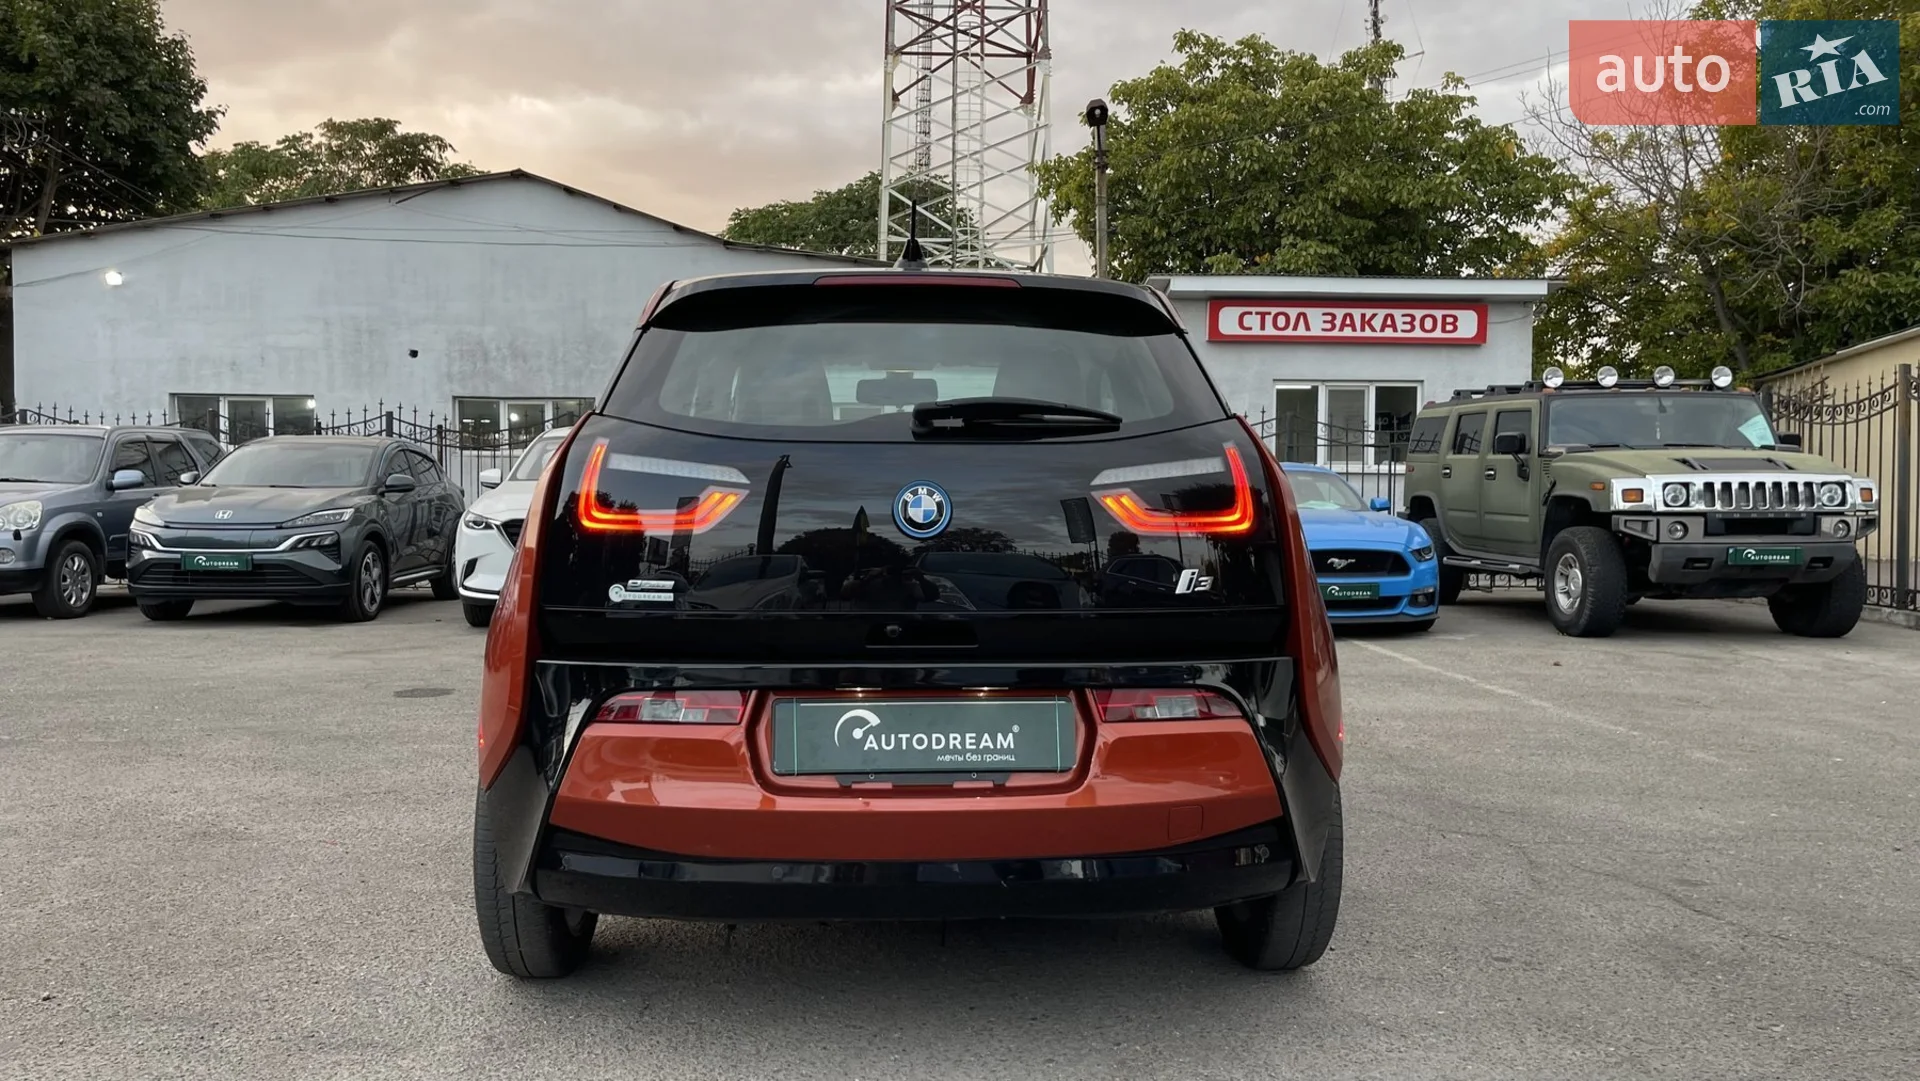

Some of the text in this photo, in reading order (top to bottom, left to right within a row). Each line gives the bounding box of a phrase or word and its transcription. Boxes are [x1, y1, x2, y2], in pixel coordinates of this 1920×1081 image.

[1237, 310, 1459, 334] СТОЛ ЗАКАЗОВ
[904, 487, 943, 502] BMW
[1175, 569, 1214, 594] i3
[937, 752, 1016, 763] мечты без границ
